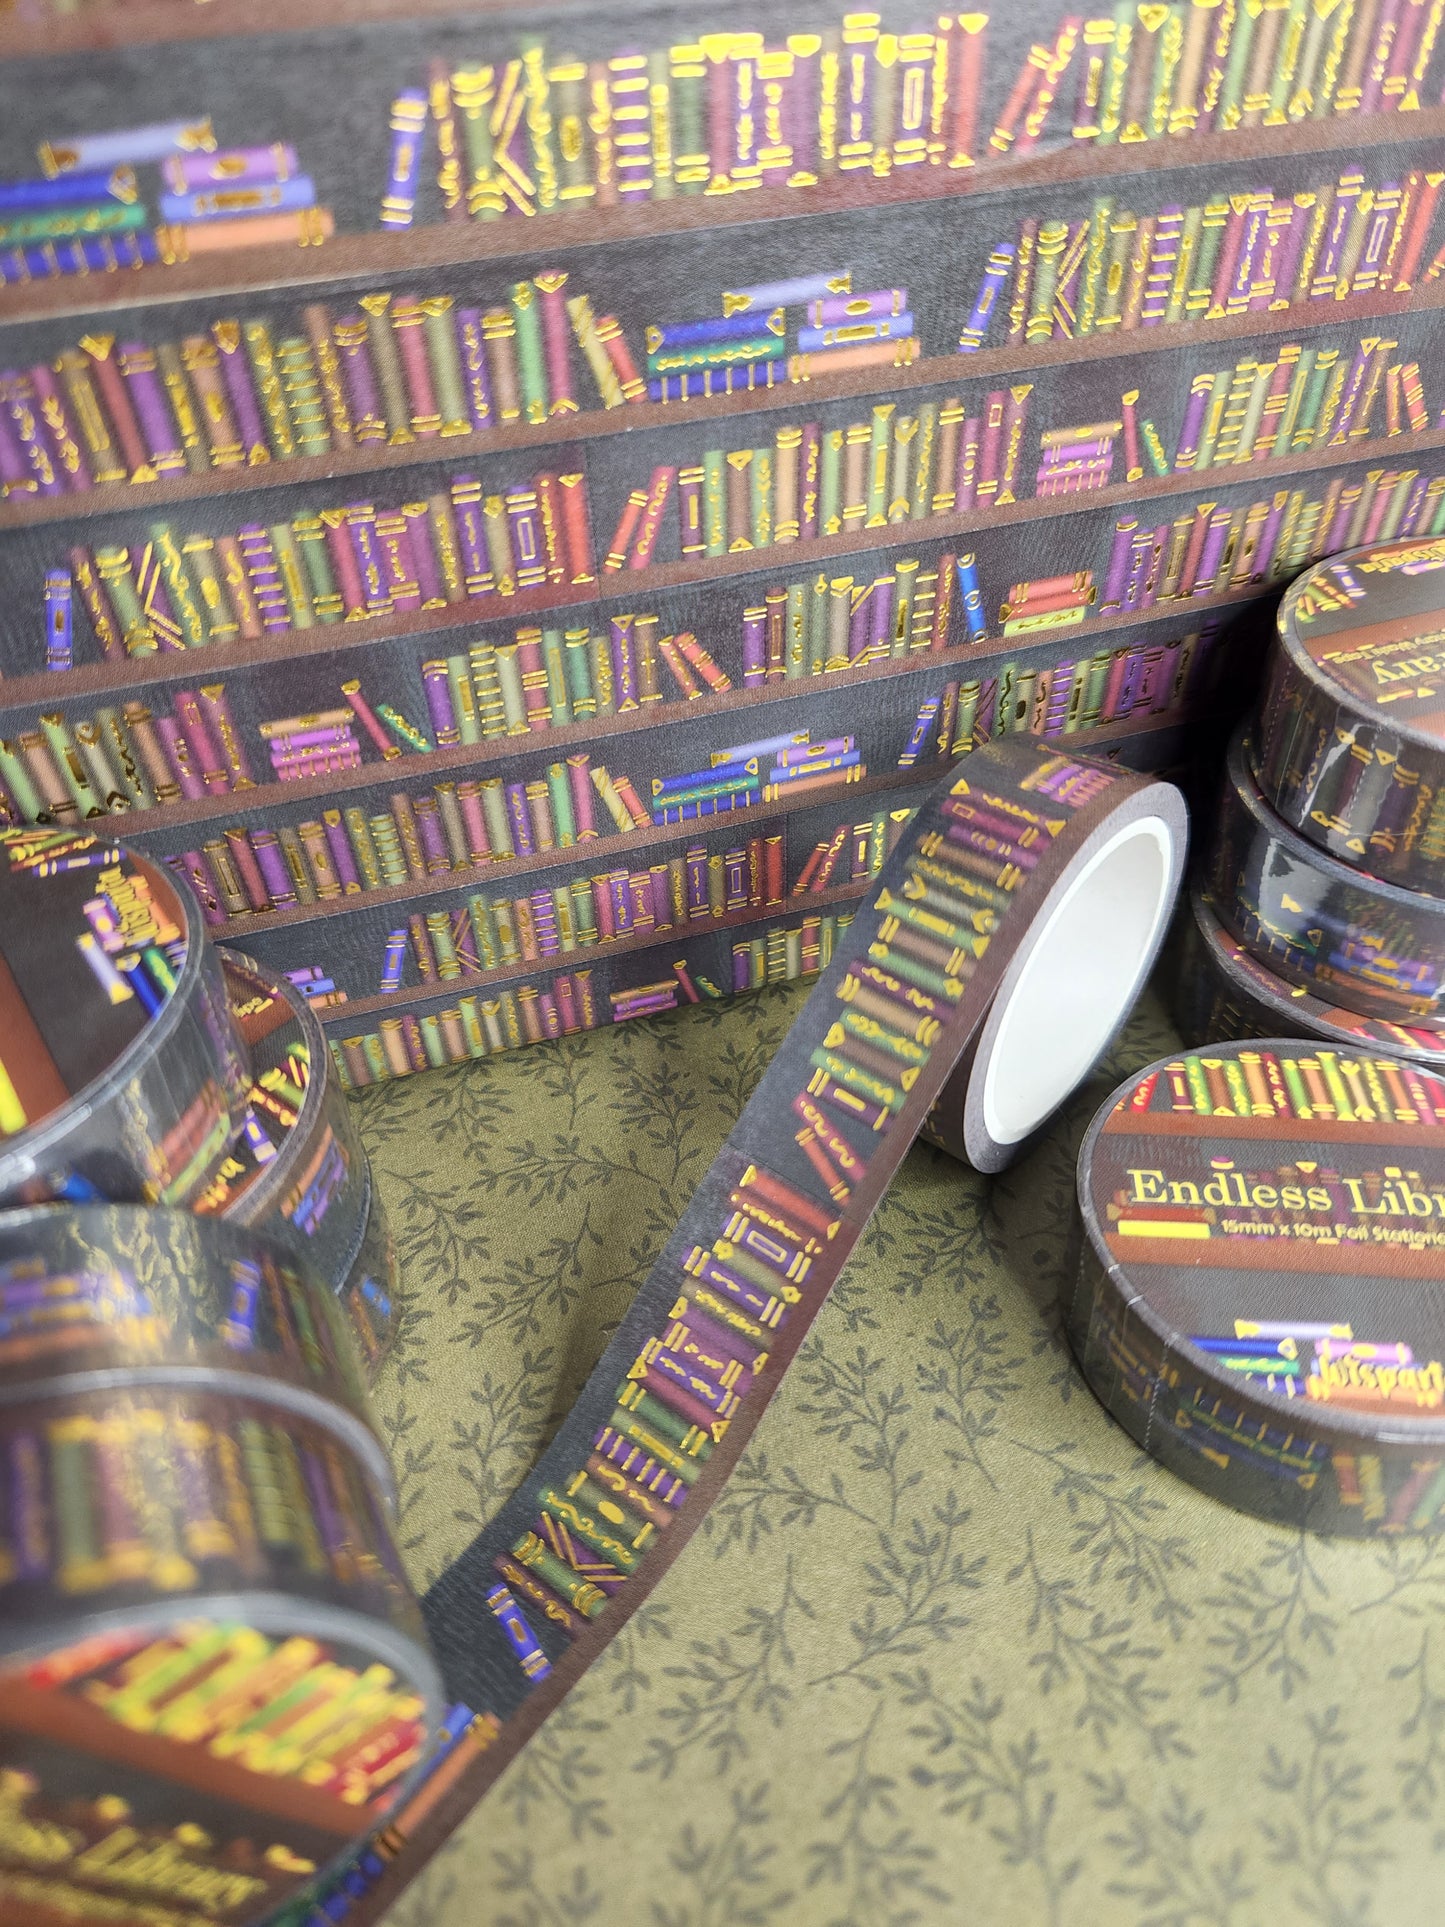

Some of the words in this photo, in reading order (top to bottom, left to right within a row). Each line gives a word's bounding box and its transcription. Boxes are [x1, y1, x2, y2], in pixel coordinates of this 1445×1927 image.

[1372, 649, 1445, 684] ary
[1126, 1168, 1333, 1212] Endless
[1221, 1219, 1276, 1236] 15mm
[1278, 1223, 1291, 1236] x
[1293, 1222, 1332, 1238] 10m
[1334, 1223, 1369, 1241] Foil
